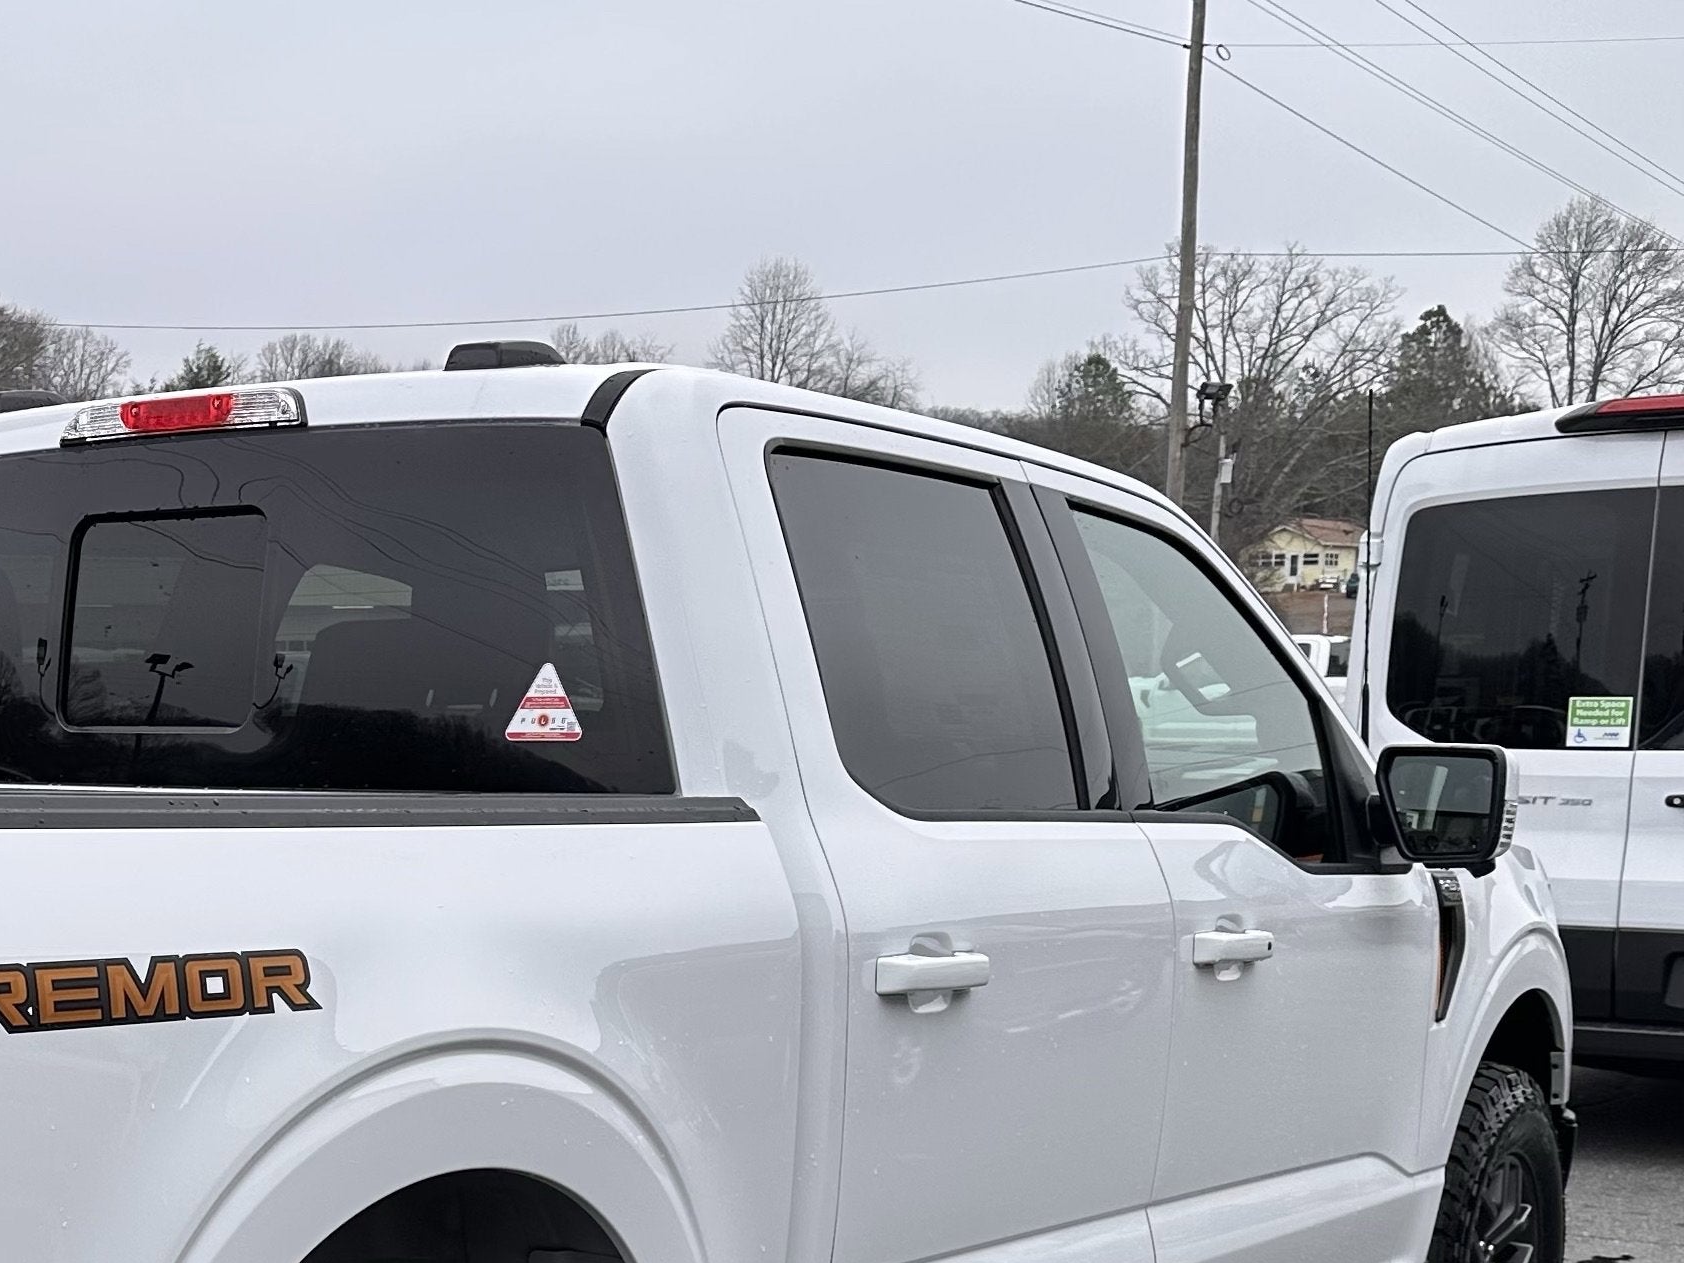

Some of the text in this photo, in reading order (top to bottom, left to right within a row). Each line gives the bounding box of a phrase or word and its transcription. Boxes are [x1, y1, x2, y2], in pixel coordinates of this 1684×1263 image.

[1600, 701, 1626, 709] Space
[1576, 709, 1625, 717] Needed for
